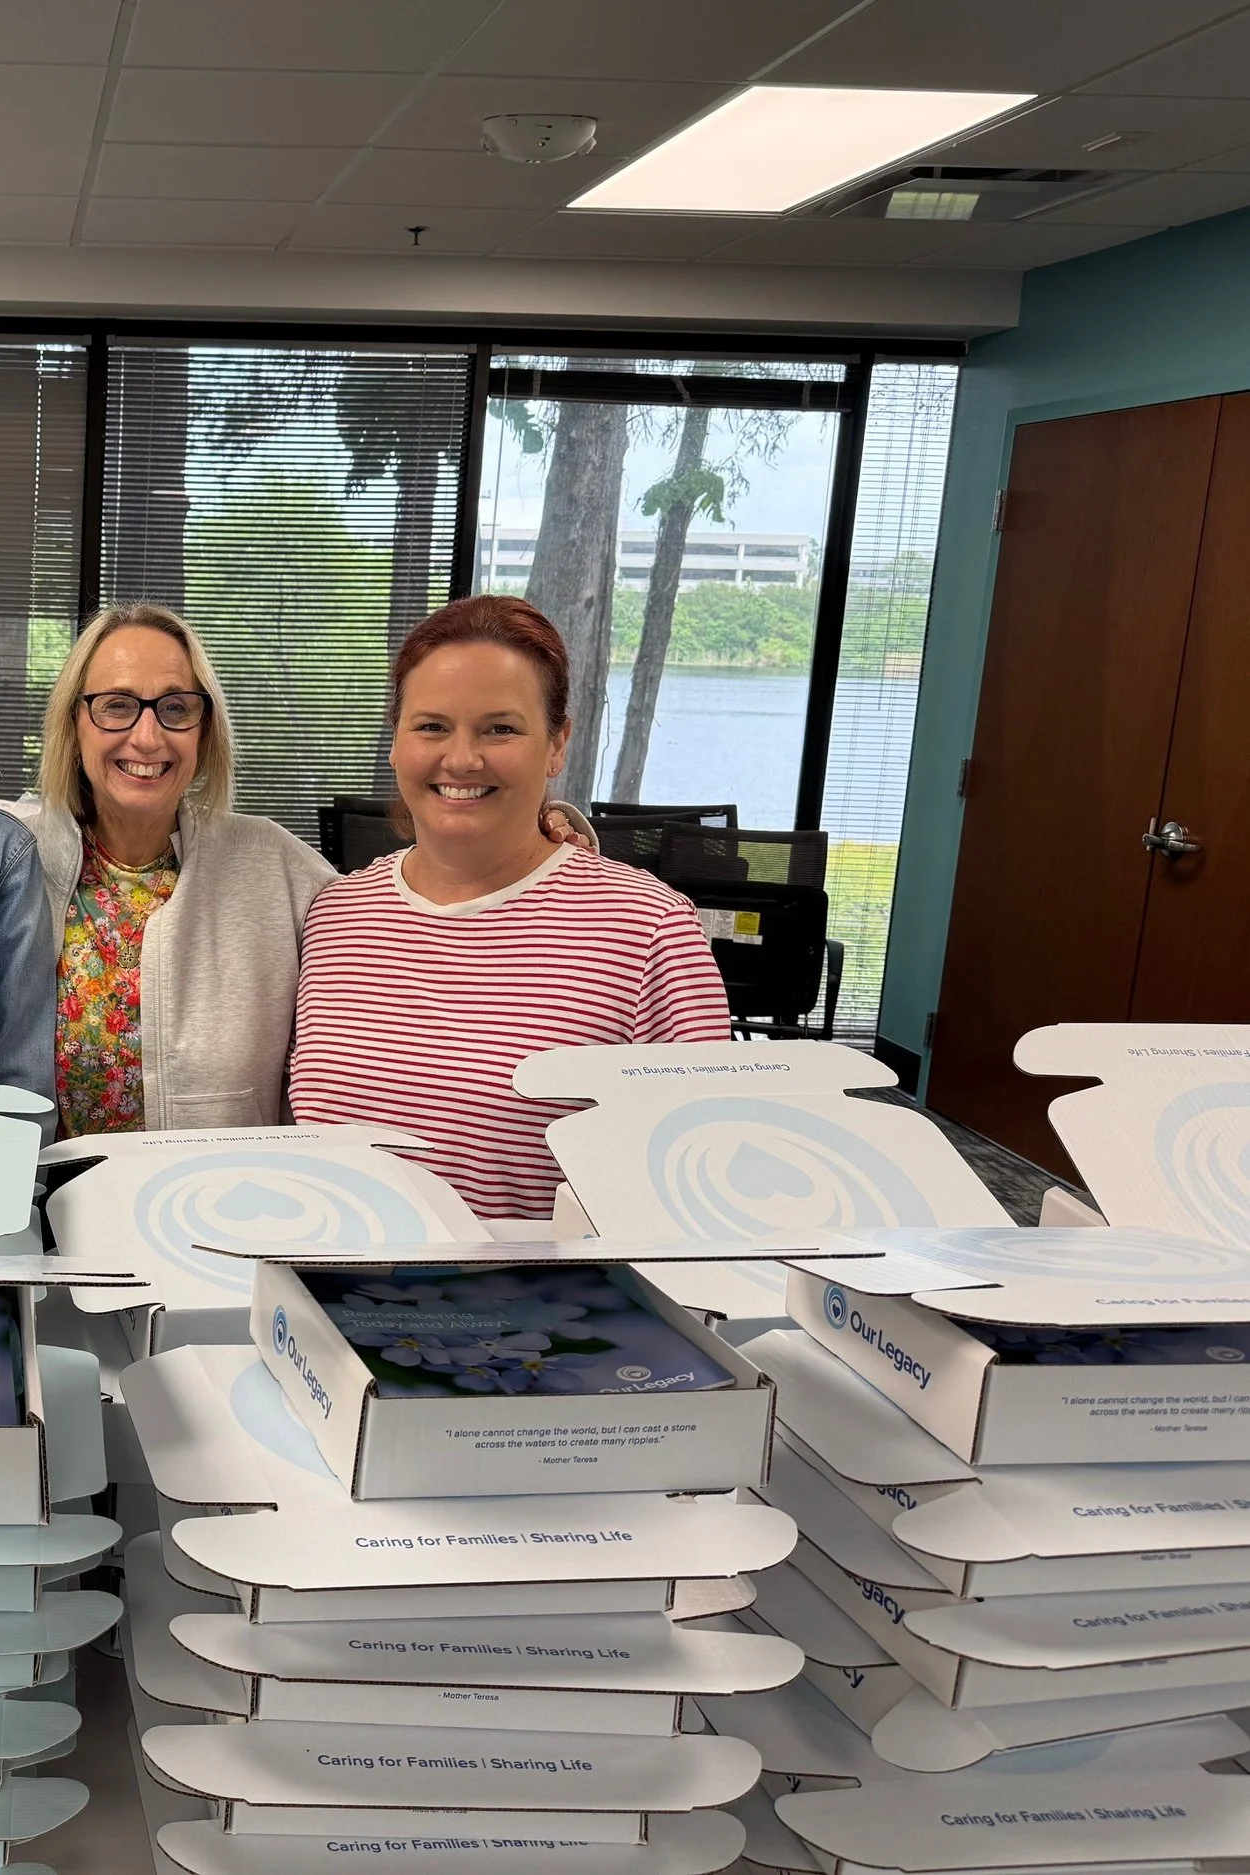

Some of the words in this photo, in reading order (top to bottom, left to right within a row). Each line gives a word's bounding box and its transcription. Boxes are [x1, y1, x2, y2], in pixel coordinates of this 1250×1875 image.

[1127, 1048, 1150, 1057] Life
[1150, 1047, 1197, 1057] Sharing
[1202, 1049, 1250, 1058] Families
[621, 1068, 642, 1076] Life
[642, 1066, 686, 1075] Sharing
[691, 1065, 738, 1074] Families
[738, 1064, 754, 1072] for
[754, 1062, 790, 1072] Caring
[342, 1310, 474, 1320] Remembering
[350, 1320, 402, 1329] Today
[409, 1321, 443, 1329] and
[450, 1320, 512, 1329] Always
[850, 1310, 877, 1343] Our
[878, 1328, 932, 1390] Legacy
[288, 1336, 303, 1371] Our
[302, 1356, 332, 1420] Legacy
[632, 1372, 694, 1391] Legacy
[542, 1456, 571, 1464] Mother
[572, 1455, 598, 1464] Teresa
[1072, 1506, 1130, 1517] Caring
[1130, 1504, 1152, 1514] for
[1155, 1500, 1225, 1512] Families
[355, 1536, 414, 1549] Caring
[416, 1535, 441, 1546] for
[445, 1533, 518, 1545] Families
[529, 1532, 598, 1544] Sharing
[599, 1530, 632, 1541] Life
[348, 1639, 407, 1653] Caring
[410, 1642, 435, 1652] for
[439, 1642, 513, 1654] Families
[525, 1646, 594, 1659] Sharing
[596, 1648, 630, 1658] Life
[442, 1691, 471, 1700] Mother
[472, 1692, 499, 1701] Teresa
[317, 1754, 374, 1769] Caring
[377, 1755, 402, 1767] for
[406, 1756, 478, 1768] Families
[490, 1758, 557, 1772] Sharing
[559, 1759, 592, 1770] Life
[940, 1813, 996, 1827] Caring
[994, 1811, 1018, 1824] for
[1018, 1810, 1086, 1823] Families
[1092, 1807, 1157, 1821] Sharing
[1153, 1805, 1186, 1818] Life
